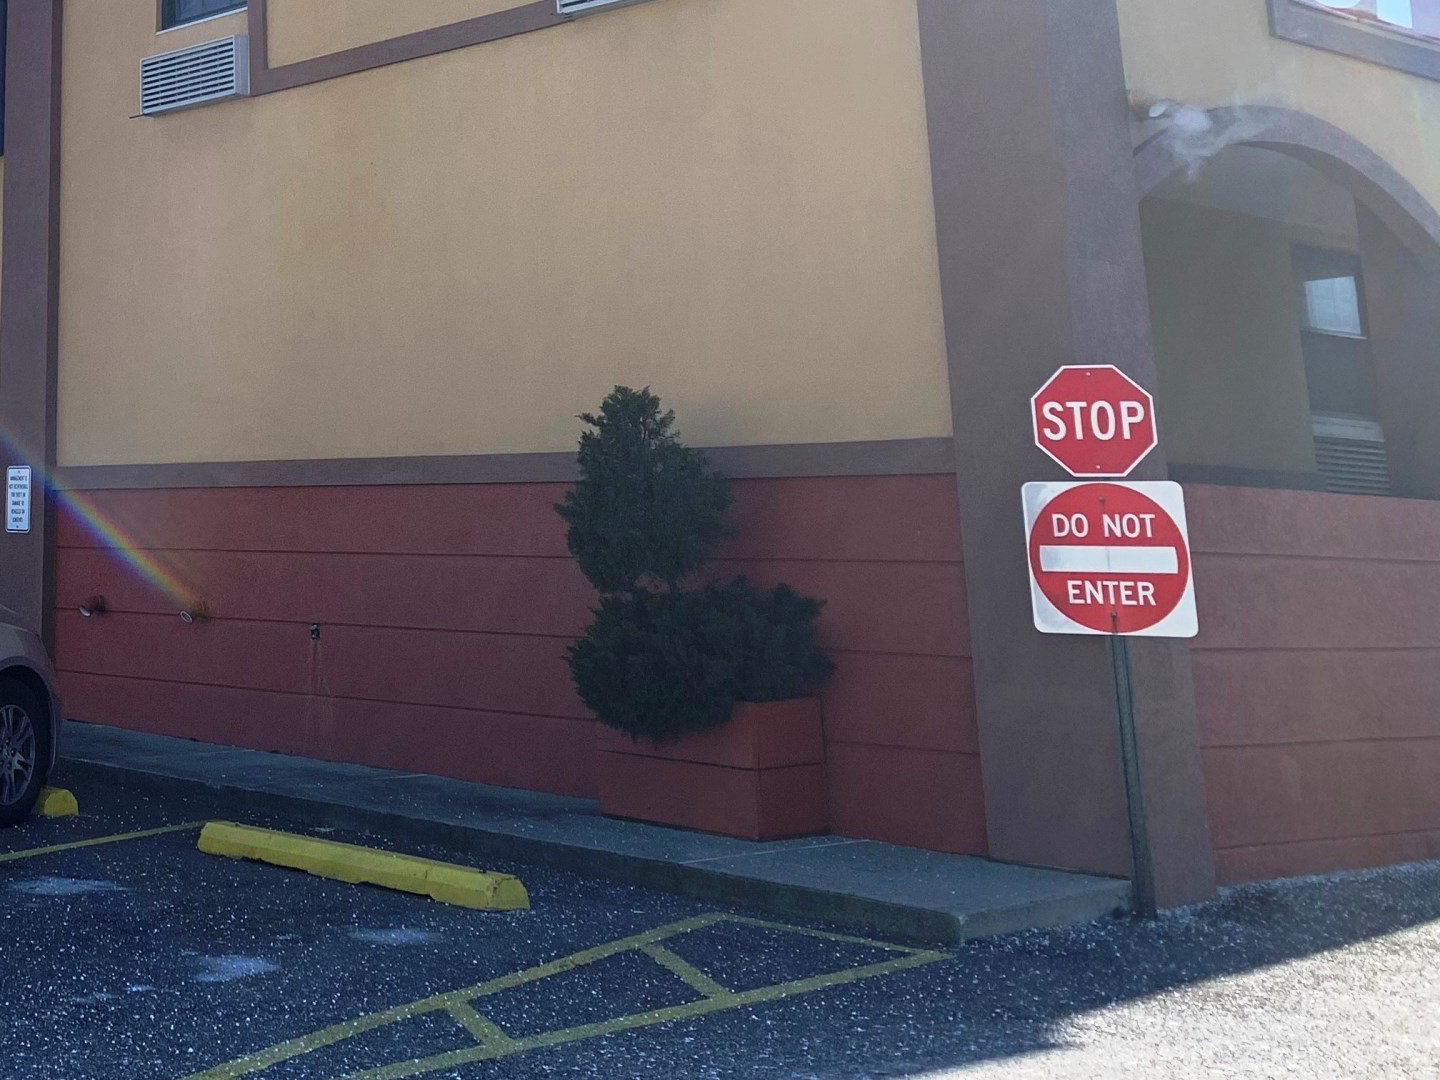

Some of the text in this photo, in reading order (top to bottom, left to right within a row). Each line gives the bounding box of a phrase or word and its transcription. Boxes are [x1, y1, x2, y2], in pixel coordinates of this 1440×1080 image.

[1042, 400, 1145, 441] STOP
[1051, 513, 1156, 538] DO NOT
[1067, 580, 1157, 606] ENTER
